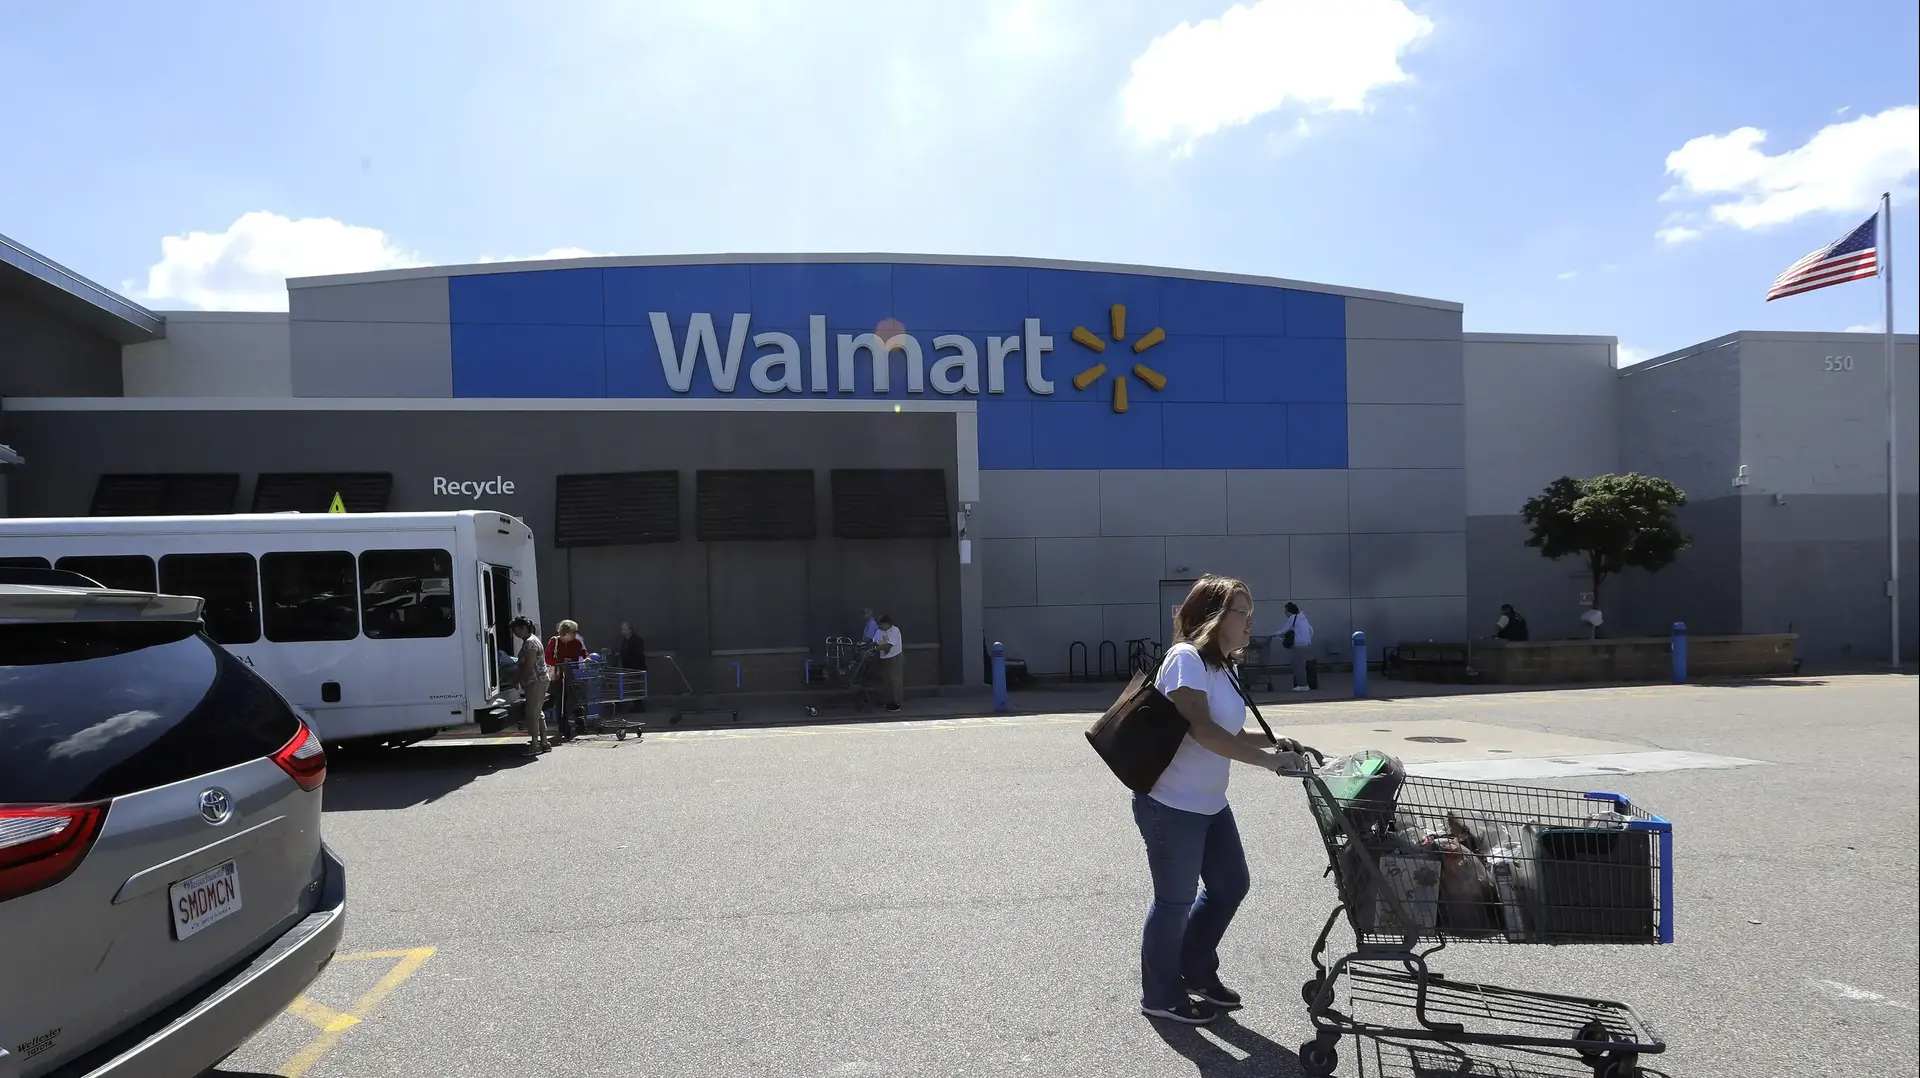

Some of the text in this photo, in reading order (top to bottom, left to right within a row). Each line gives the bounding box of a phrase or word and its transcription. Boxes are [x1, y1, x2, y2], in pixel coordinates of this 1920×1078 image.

[648, 311, 1055, 395] Walmart
[1824, 355, 1853, 371] 550
[433, 475, 515, 500] Recycle
[179, 875, 235, 924] SMDMCN
[17, 1025, 64, 1052] Wellesley
[26, 1040, 53, 1056] TOYOTA
